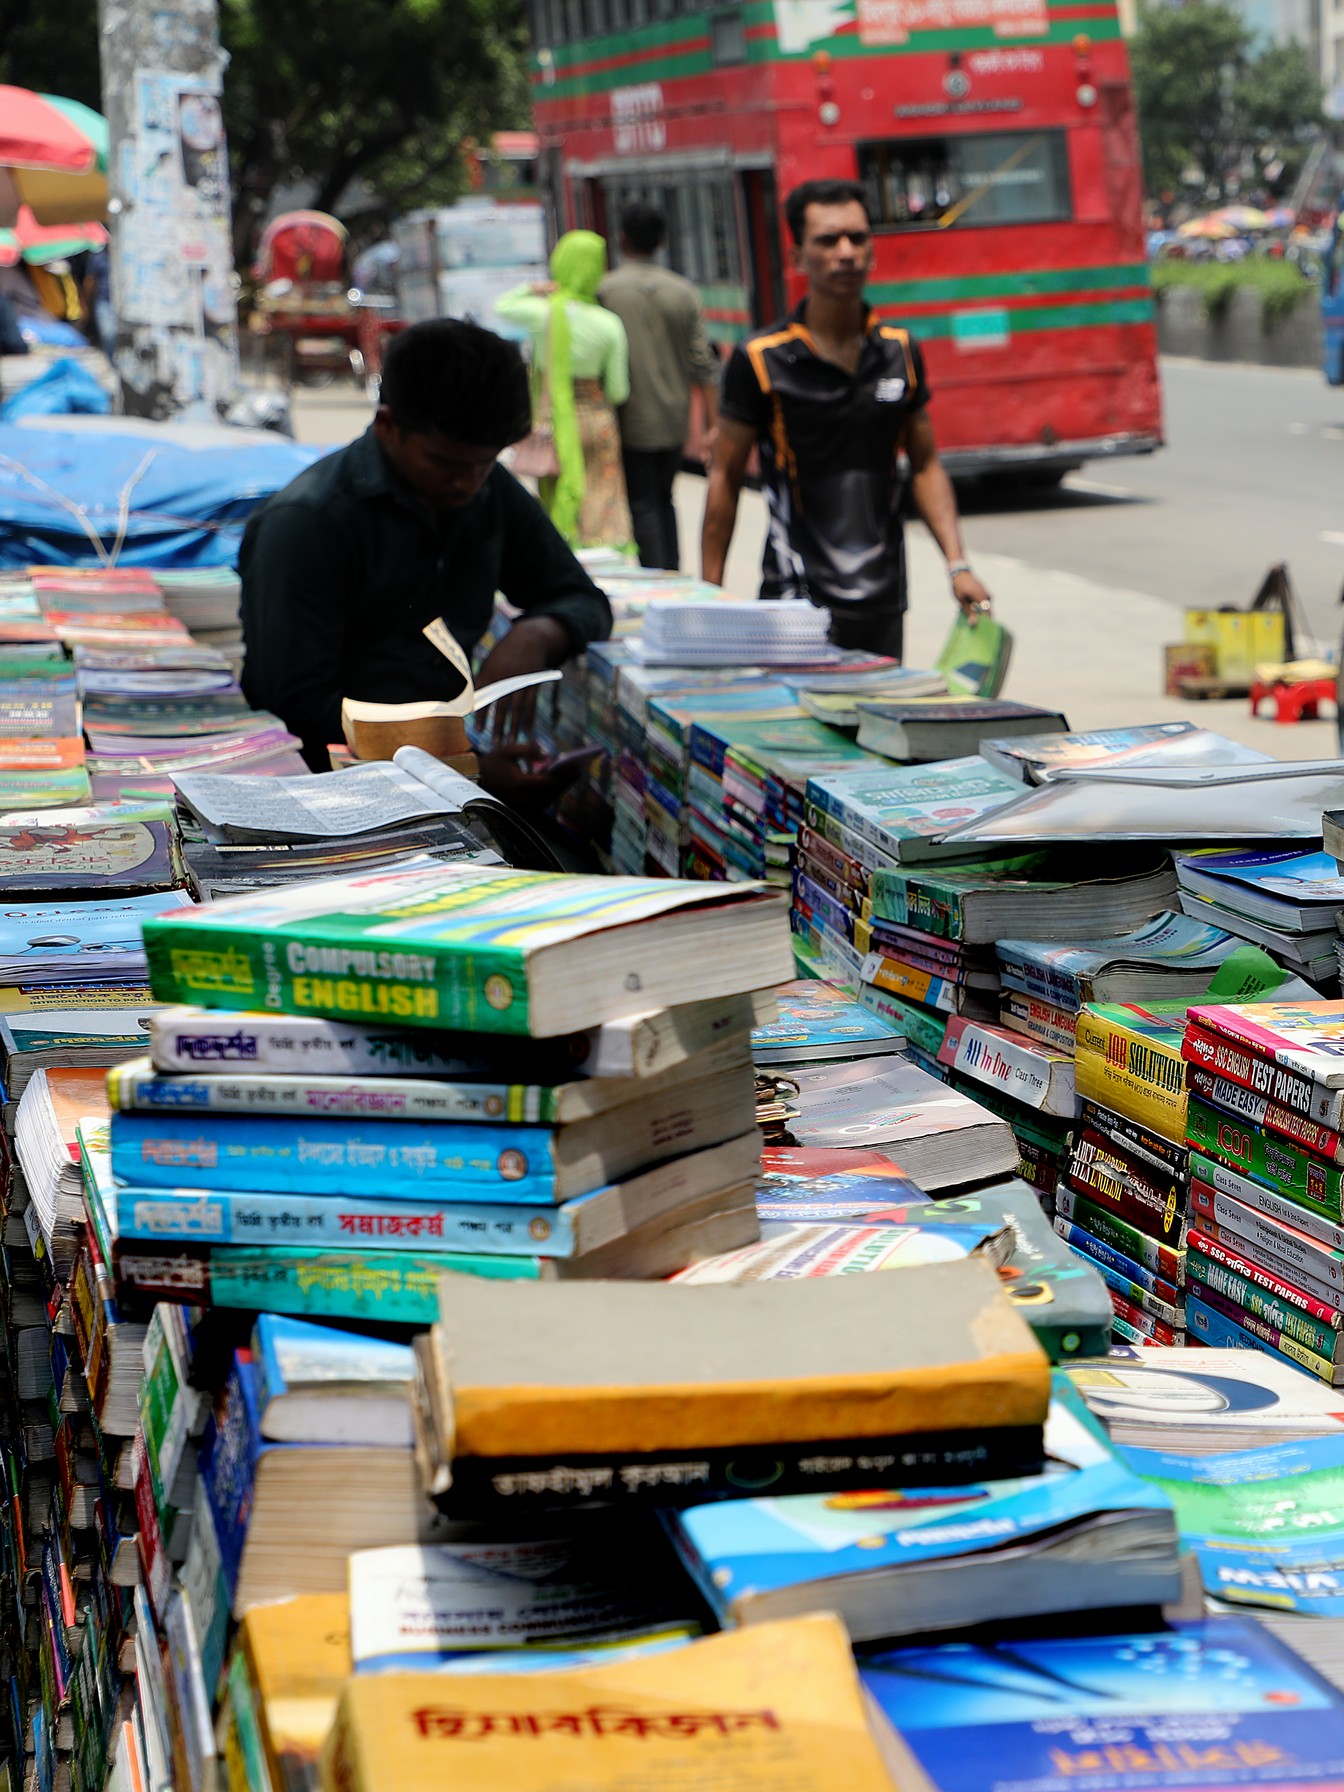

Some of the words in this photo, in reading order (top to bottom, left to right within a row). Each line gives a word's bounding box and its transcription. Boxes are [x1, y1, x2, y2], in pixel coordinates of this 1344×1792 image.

[264, 942, 277, 1008] Degree
[286, 941, 437, 982] COMPULSORY
[1023, 963, 1046, 984] ENGLISH
[1045, 969, 1076, 994] LANGUAGE
[292, 977, 440, 1019] ENGLISH
[1030, 1002, 1050, 1022] ENGLISH
[1050, 1010, 1076, 1034] LANGUAGE
[1027, 1021, 1046, 1036] GRAMMAR
[1050, 1029, 1075, 1048] COMPOSITION
[963, 1037, 980, 1067] All
[981, 1044, 993, 1072] In
[992, 1051, 1012, 1082] One
[1085, 1029, 1106, 1051] Current
[1106, 1032, 1127, 1071] JOB
[1128, 1041, 1185, 1096] SOLUTION
[1015, 1067, 1028, 1082] Class
[1028, 1072, 1043, 1089] Three
[1215, 1045, 1229, 1071] SSC
[1226, 1049, 1251, 1080] ENGLISH
[1250, 1059, 1276, 1092] TEST
[1274, 1069, 1312, 1113] PAPERS
[1215, 1078, 1238, 1106] MADE
[1238, 1090, 1261, 1115] EASY
[1260, 1104, 1266, 1114] to
[1274, 1107, 1292, 1132] ENGLISH
[1301, 1121, 1320, 1144] PAPERS
[1215, 1174, 1227, 1188] Class
[1228, 1179, 1242, 1193] Seven
[1216, 1203, 1228, 1216] Class
[1228, 1209, 1242, 1223] Seven
[1258, 1195, 1282, 1214] ENGLISH
[337, 1211, 446, 1238] সমাজকর্ম
[1220, 1230, 1232, 1243] Class
[1233, 1237, 1246, 1251] Seven
[1259, 1233, 1273, 1246] Religion
[1277, 1243, 1286, 1254] Moral
[1286, 1248, 1304, 1264] Education
[1210, 1246, 1226, 1262] SSC
[1225, 1256, 1253, 1276] গণিত
[1253, 1271, 1275, 1290] TEST
[1274, 1281, 1309, 1310] PAPERS
[1207, 1263, 1227, 1295] MADE
[1226, 1271, 1247, 1306] EASY
[1250, 1293, 1264, 1316] SSC
[1262, 1299, 1284, 1330] গণিত
[1298, 1318, 1317, 1349] PAPERS
[1217, 1564, 1341, 1589] VIEW
